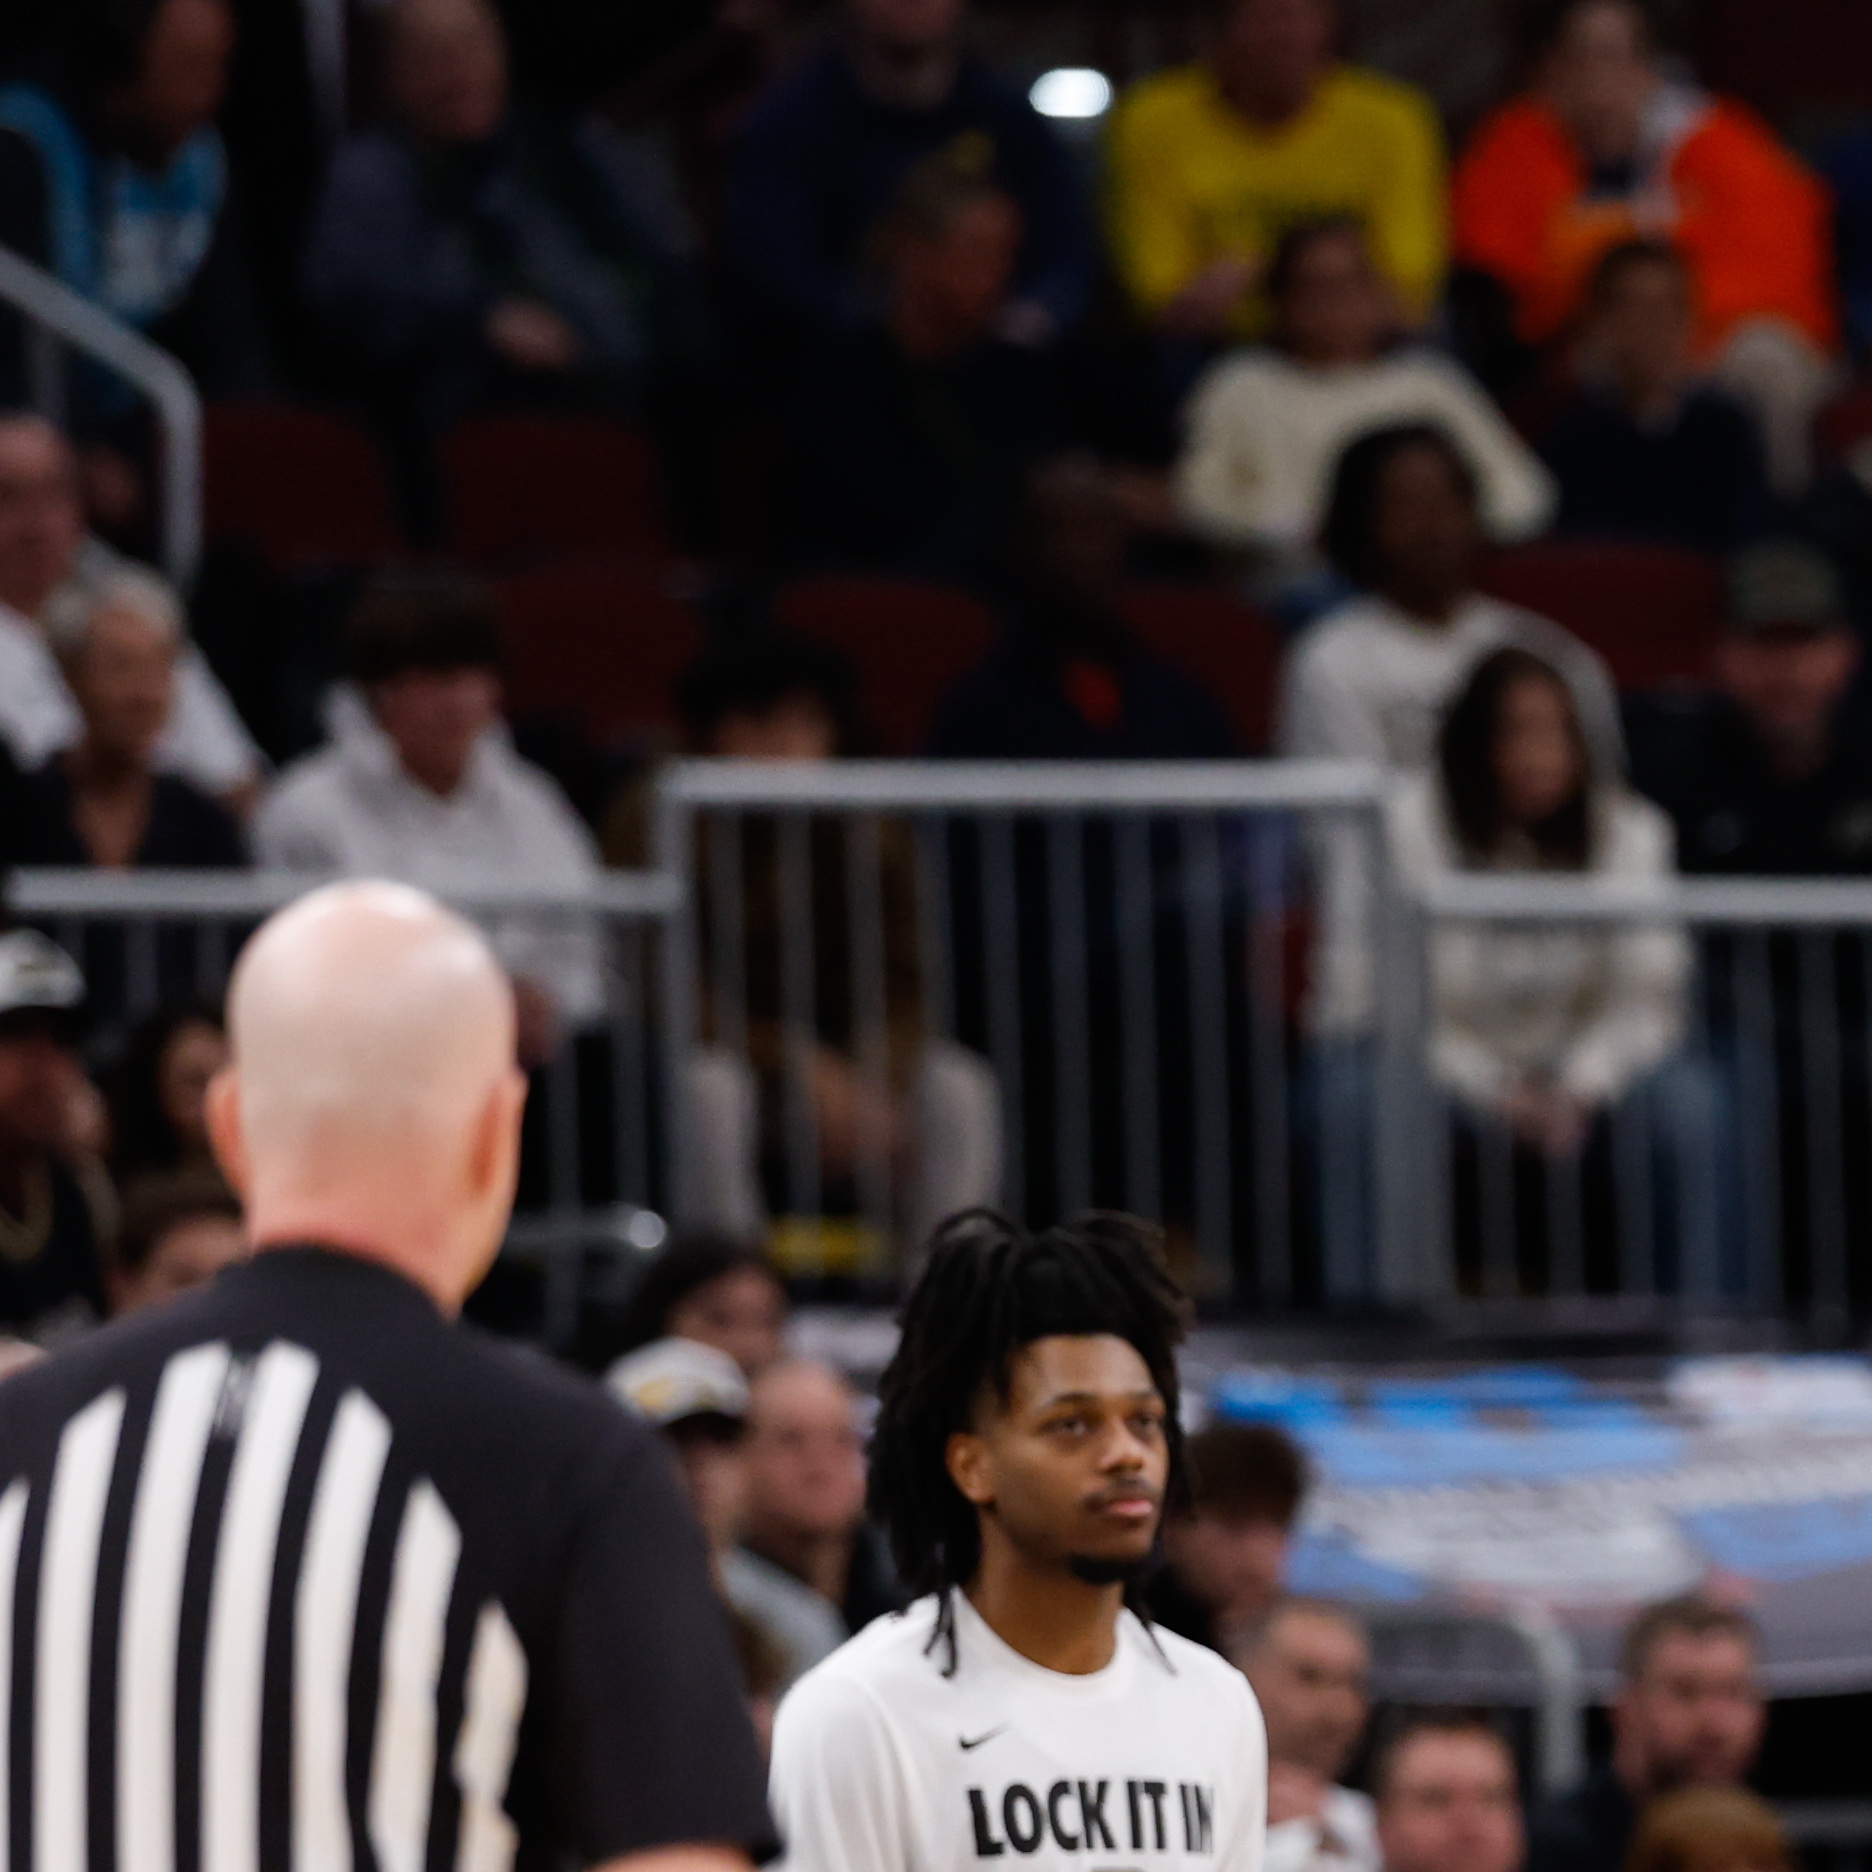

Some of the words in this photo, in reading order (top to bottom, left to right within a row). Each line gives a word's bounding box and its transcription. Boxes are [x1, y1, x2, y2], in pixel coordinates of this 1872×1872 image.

[967, 1777, 1116, 1857] LOCK
[1127, 1777, 1169, 1851] IT
[1180, 1781, 1214, 1856] IN
